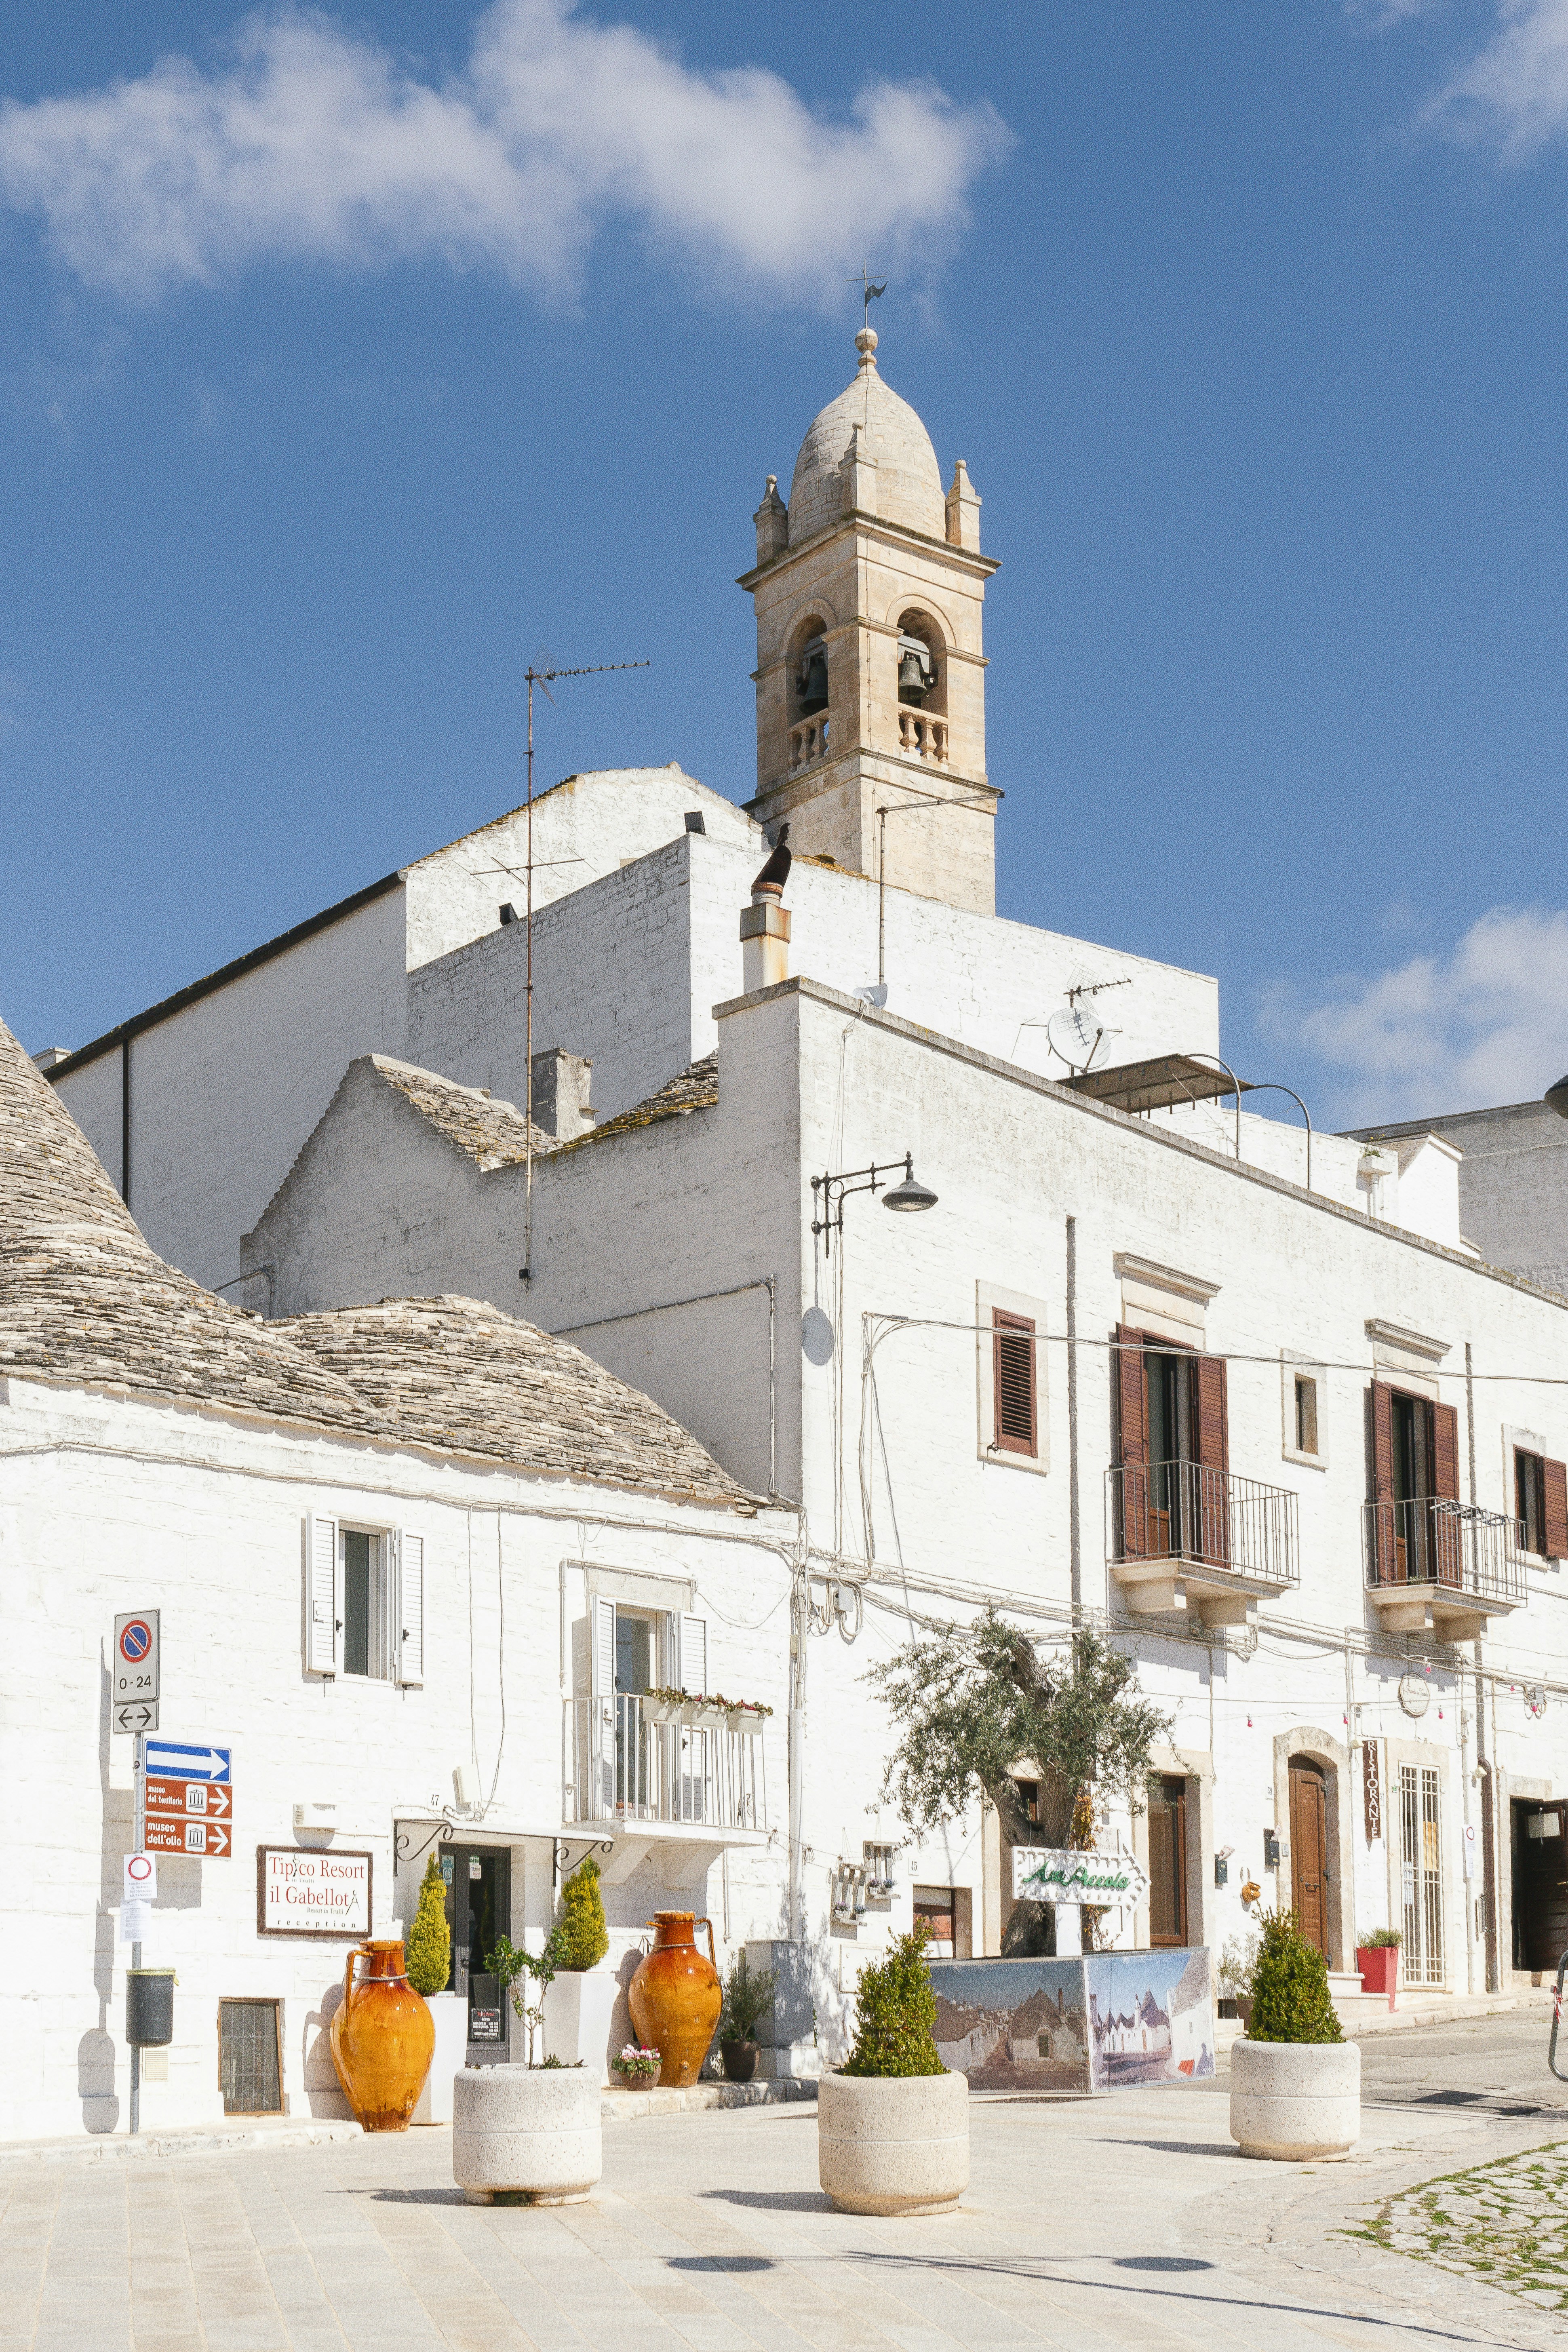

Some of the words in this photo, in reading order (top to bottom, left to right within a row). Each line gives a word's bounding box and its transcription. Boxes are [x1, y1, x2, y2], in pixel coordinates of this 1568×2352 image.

[120, 1678, 127, 1689] 0
[137, 1675, 152, 1688] 24
[148, 1785, 166, 1794] museo
[1367, 1740, 1379, 1838] RISTORANTE
[148, 1794, 156, 1803] del
[158, 1795, 183, 1806] territorio
[147, 1822, 175, 1833] museo
[147, 1834, 182, 1846] dell'olio
[320, 1859, 365, 1879] Resort
[910, 1861, 917, 1871] 45
[270, 1885, 280, 1903] il
[278, 1920, 356, 1928] reception
